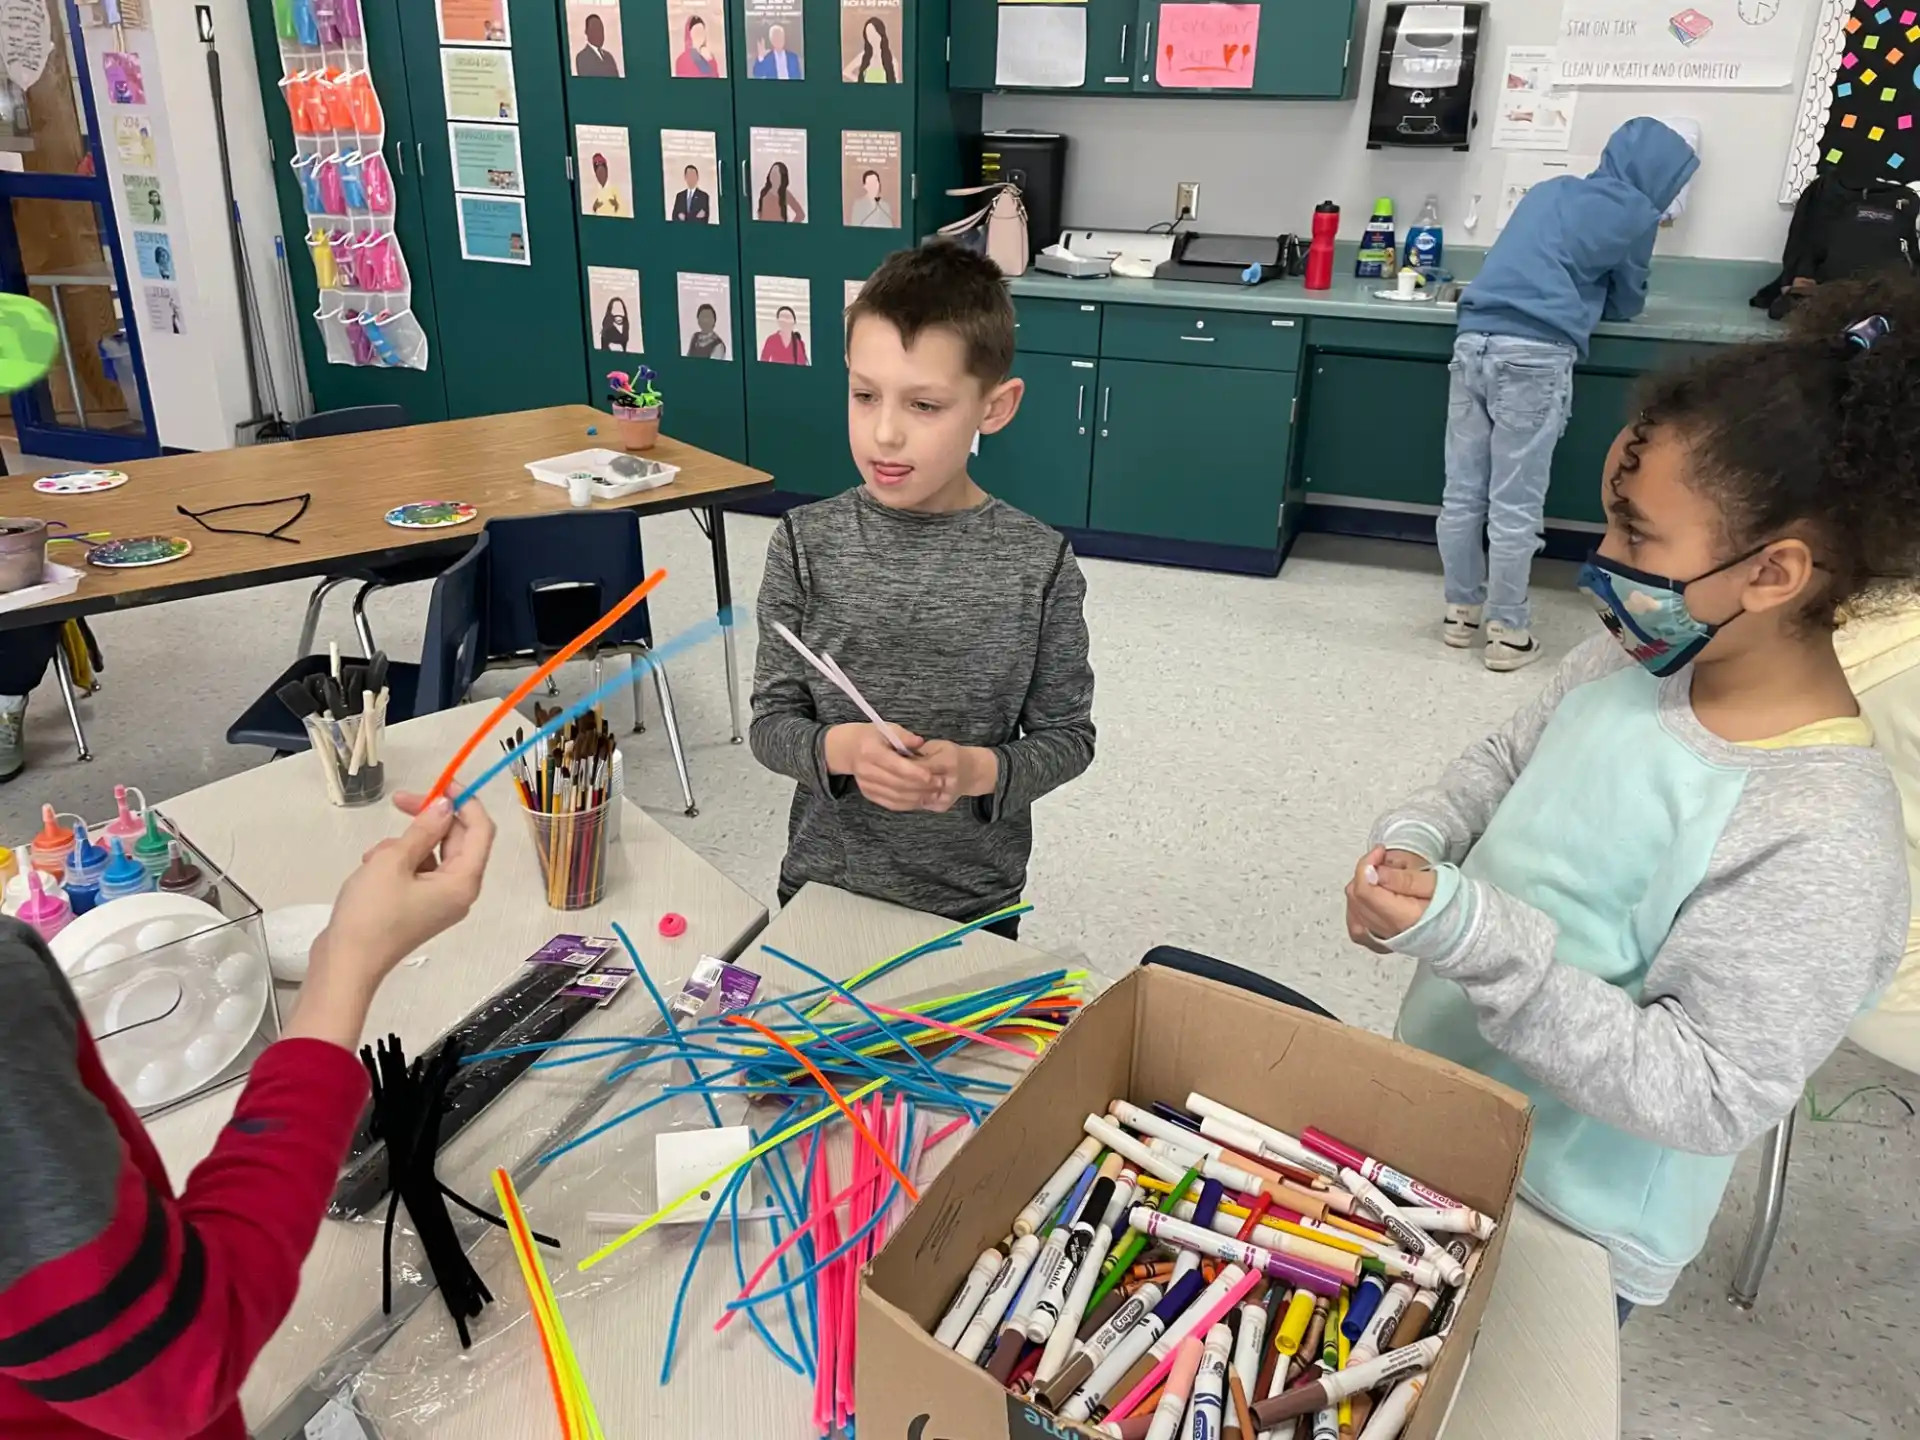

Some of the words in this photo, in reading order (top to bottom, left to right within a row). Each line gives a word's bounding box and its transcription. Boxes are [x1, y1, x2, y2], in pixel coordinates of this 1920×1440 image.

[1566, 20, 1590, 37] STAY
[1593, 20, 1610, 37] ON
[1613, 20, 1637, 37] TASK
[1562, 60, 1594, 78] CLEAN
[1597, 61, 1610, 78] UP
[1612, 62, 1651, 79] NEATLY
[1652, 62, 1675, 79] AND
[1678, 62, 1742, 80] COMPLETELY
[1415, 1182, 1455, 1209] Crayola
[1386, 1216, 1421, 1253] Crayola
[1113, 1301, 1142, 1331] Crayola
